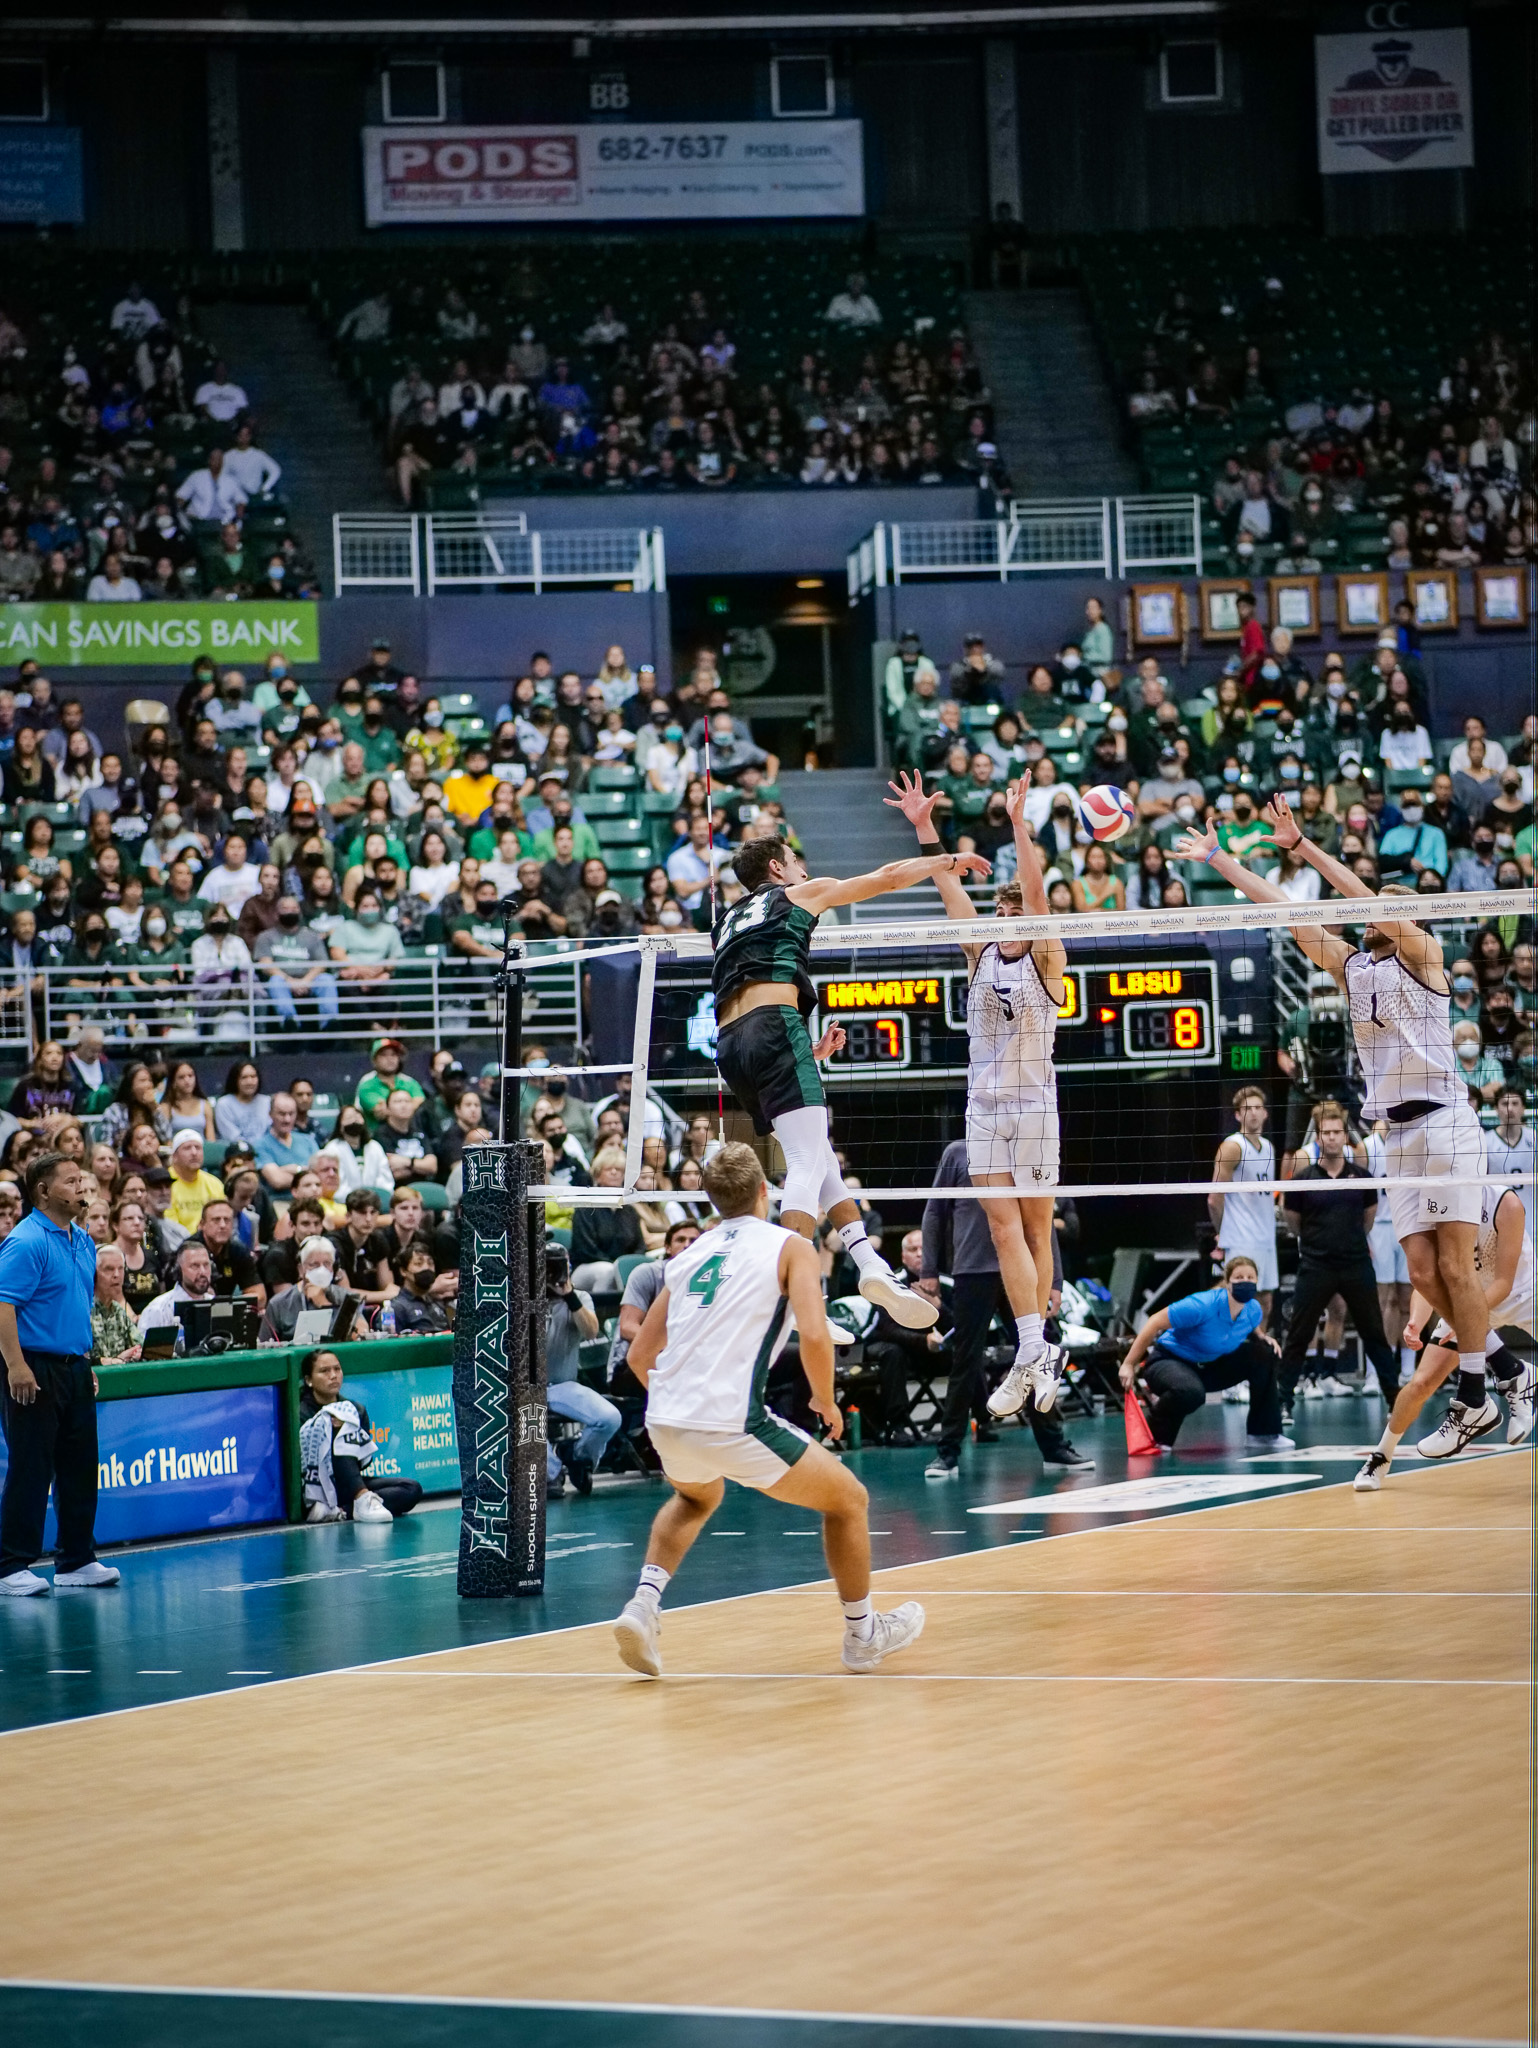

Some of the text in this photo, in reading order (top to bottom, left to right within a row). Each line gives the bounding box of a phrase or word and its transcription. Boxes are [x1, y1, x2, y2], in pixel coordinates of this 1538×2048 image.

[1366, 3, 1410, 29] CC
[590, 83, 629, 109] BB
[598, 135, 728, 161] 682-7637
[386, 141, 574, 179] PODS
[389, 184, 464, 205] Moving
[492, 181, 572, 204] Storage
[67, 618, 201, 649] SAVINGS
[211, 617, 303, 646] BANK
[1335, 907, 1370, 917] HAWAIIAN
[1382, 904, 1418, 914] HAWAIIAN
[1431, 901, 1466, 911] HAWAIIAN
[1479, 899, 1515, 909] HAWAIIAN
[1149, 917, 1184, 927] HAWAIIAN
[1196, 915, 1230, 925] HAWAIIAN
[1242, 912, 1276, 922] HAWAIIAN
[1289, 909, 1323, 919] HAWAIIAN
[926, 929, 960, 939] HAWAIIAN
[970, 926, 1004, 936] HAWAIIAN
[1015, 924, 1048, 934] HAWAIIAN
[1060, 922, 1093, 932] HAWAIIAN
[1104, 920, 1139, 930] HAWAIIAN
[841, 933, 872, 943] HAWAIIAN
[883, 931, 916, 941] HAWAIIAN
[1109, 969, 1182, 997] LBSU
[993, 984, 1015, 1022] 5
[1371, 992, 1386, 1028] 1
[1174, 1007, 1200, 1049] 8
[876, 1019, 900, 1058] 7
[1231, 1046, 1260, 1070] EXIT
[686, 1251, 732, 1309] 4
[412, 1413, 452, 1431] PACIFIC
[413, 1432, 453, 1451] HEALTH
[129, 1448, 156, 1487] of
[159, 1436, 238, 1482] Hawaii
[528, 1463, 538, 1512] sports
[526, 1513, 538, 1573] imports
